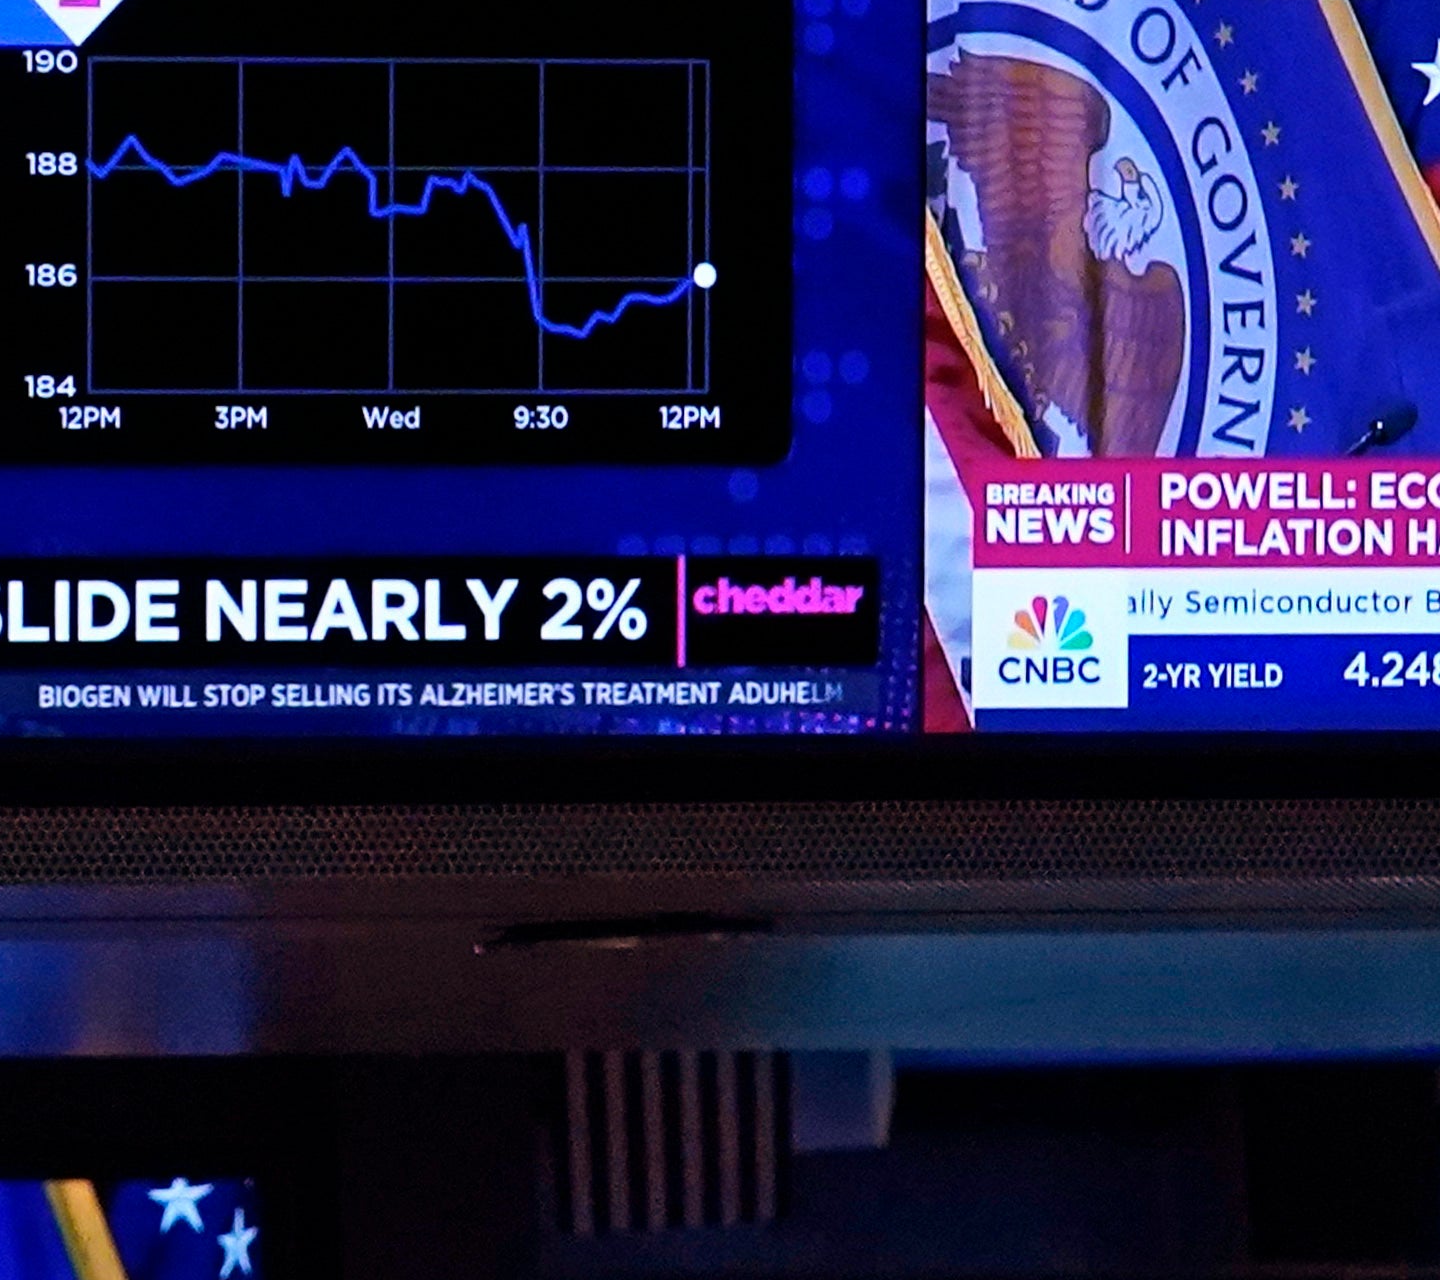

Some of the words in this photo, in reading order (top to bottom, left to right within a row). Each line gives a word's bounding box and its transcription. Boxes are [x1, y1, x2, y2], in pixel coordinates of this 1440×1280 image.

[23, 50, 78, 73] 190
[25, 154, 77, 176] 188
[25, 264, 77, 286] 186
[24, 375, 76, 398] 184
[59, 406, 121, 431] 12PM
[215, 405, 268, 431] 3PM
[362, 405, 421, 431] Wed
[513, 405, 569, 430] 9:30
[660, 405, 721, 431] 12PM
[986, 482, 1114, 505] BREAKING
[986, 509, 1114, 543] NEWS
[206, 578, 519, 641] NEARLY
[540, 578, 647, 641] 2%
[692, 578, 864, 616] cheddar
[998, 657, 1101, 684] CNBC
[1143, 665, 1201, 689] 2-YR
[1208, 664, 1283, 688] YIELD
[39, 684, 131, 708] BIOGEN
[138, 685, 196, 707] WILL
[204, 685, 265, 707] STOP
[272, 684, 370, 707] SELLING
[378, 684, 412, 707] ITS
[420, 683, 575, 706] ALZHEIMER'S
[582, 682, 719, 705] TREATMENT
